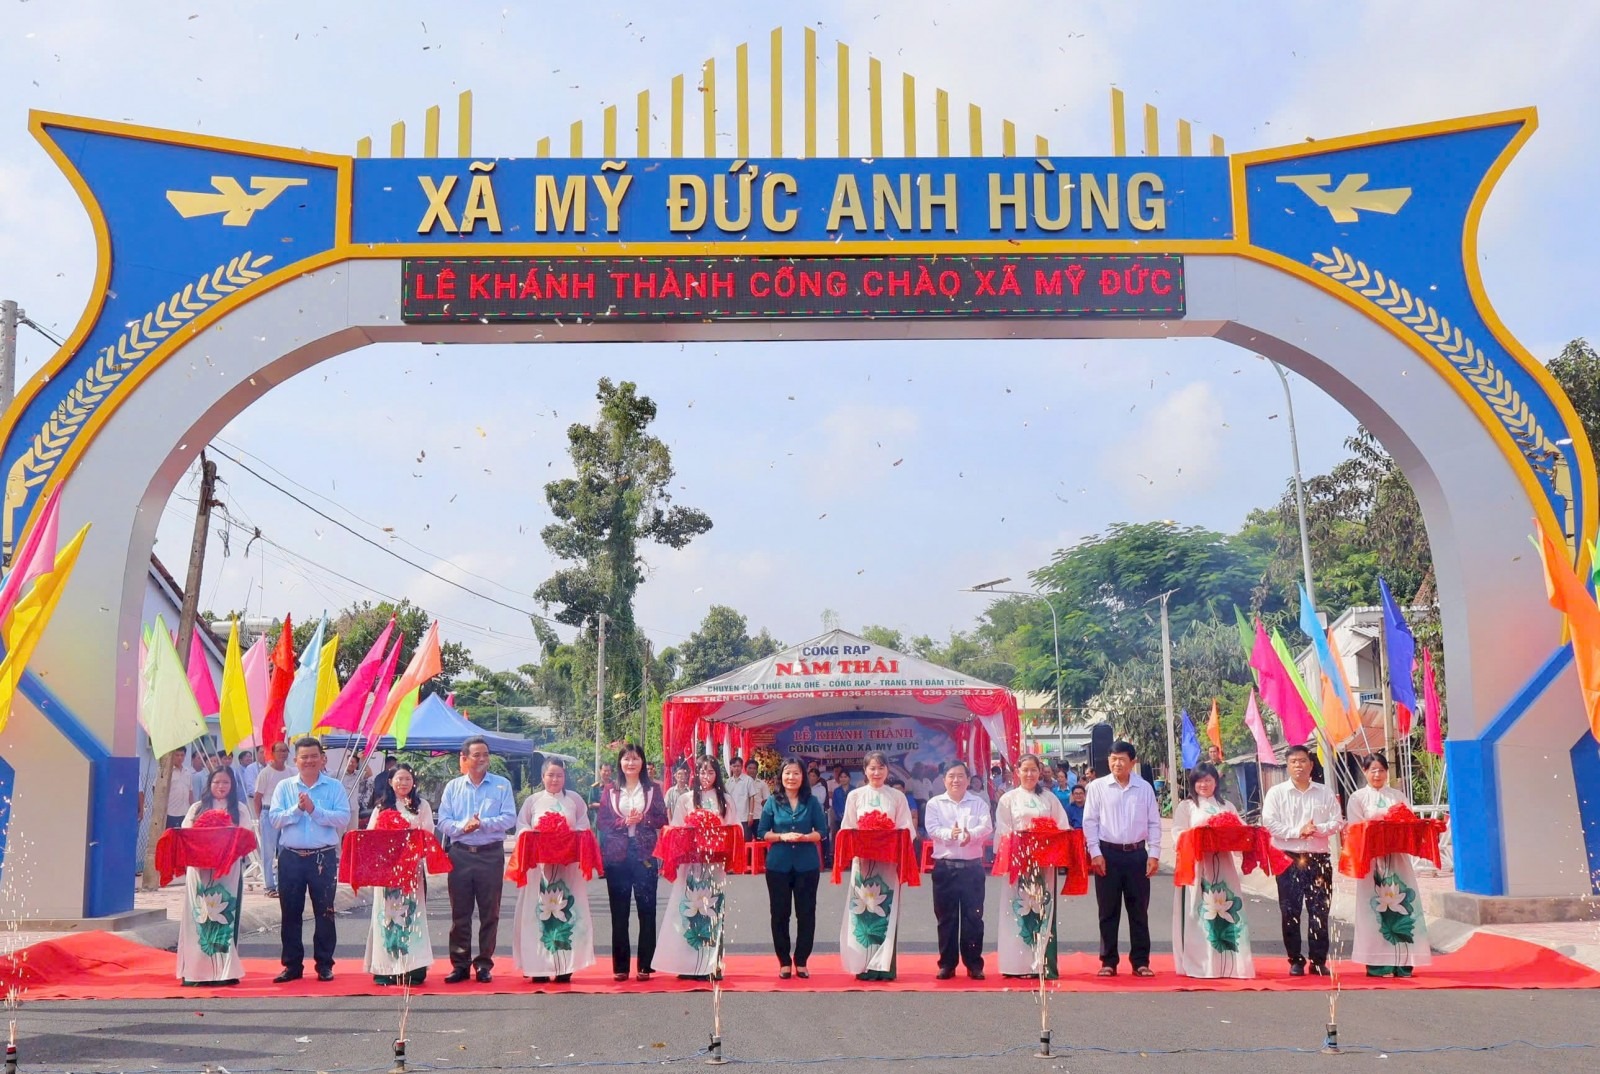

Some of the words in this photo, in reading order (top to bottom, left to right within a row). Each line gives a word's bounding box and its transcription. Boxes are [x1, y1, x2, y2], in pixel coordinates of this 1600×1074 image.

[417, 160, 502, 233] XÃ
[534, 160, 634, 233] MỸ
[666, 159, 798, 233] ĐỨC
[826, 173, 958, 231] ANH
[988, 159, 1166, 231] HÙNG
[415, 268, 457, 299] LỄ
[469, 267, 596, 299] KHÁNH
[610, 267, 736, 299] THÀNH
[863, 265, 961, 297] CHÀO
[974, 264, 1022, 296] XÃ
[1034, 264, 1086, 296] MỸ
[1098, 263, 1172, 296] ĐỨC
[843, 645, 871, 657] RẠP
[775, 658, 832, 676] NĂM
[837, 656, 899, 674] THÁI
[786, 691, 814, 699] 400M
[815, 727, 864, 741] KHÁNH
[868, 727, 913, 740] THÀNH
